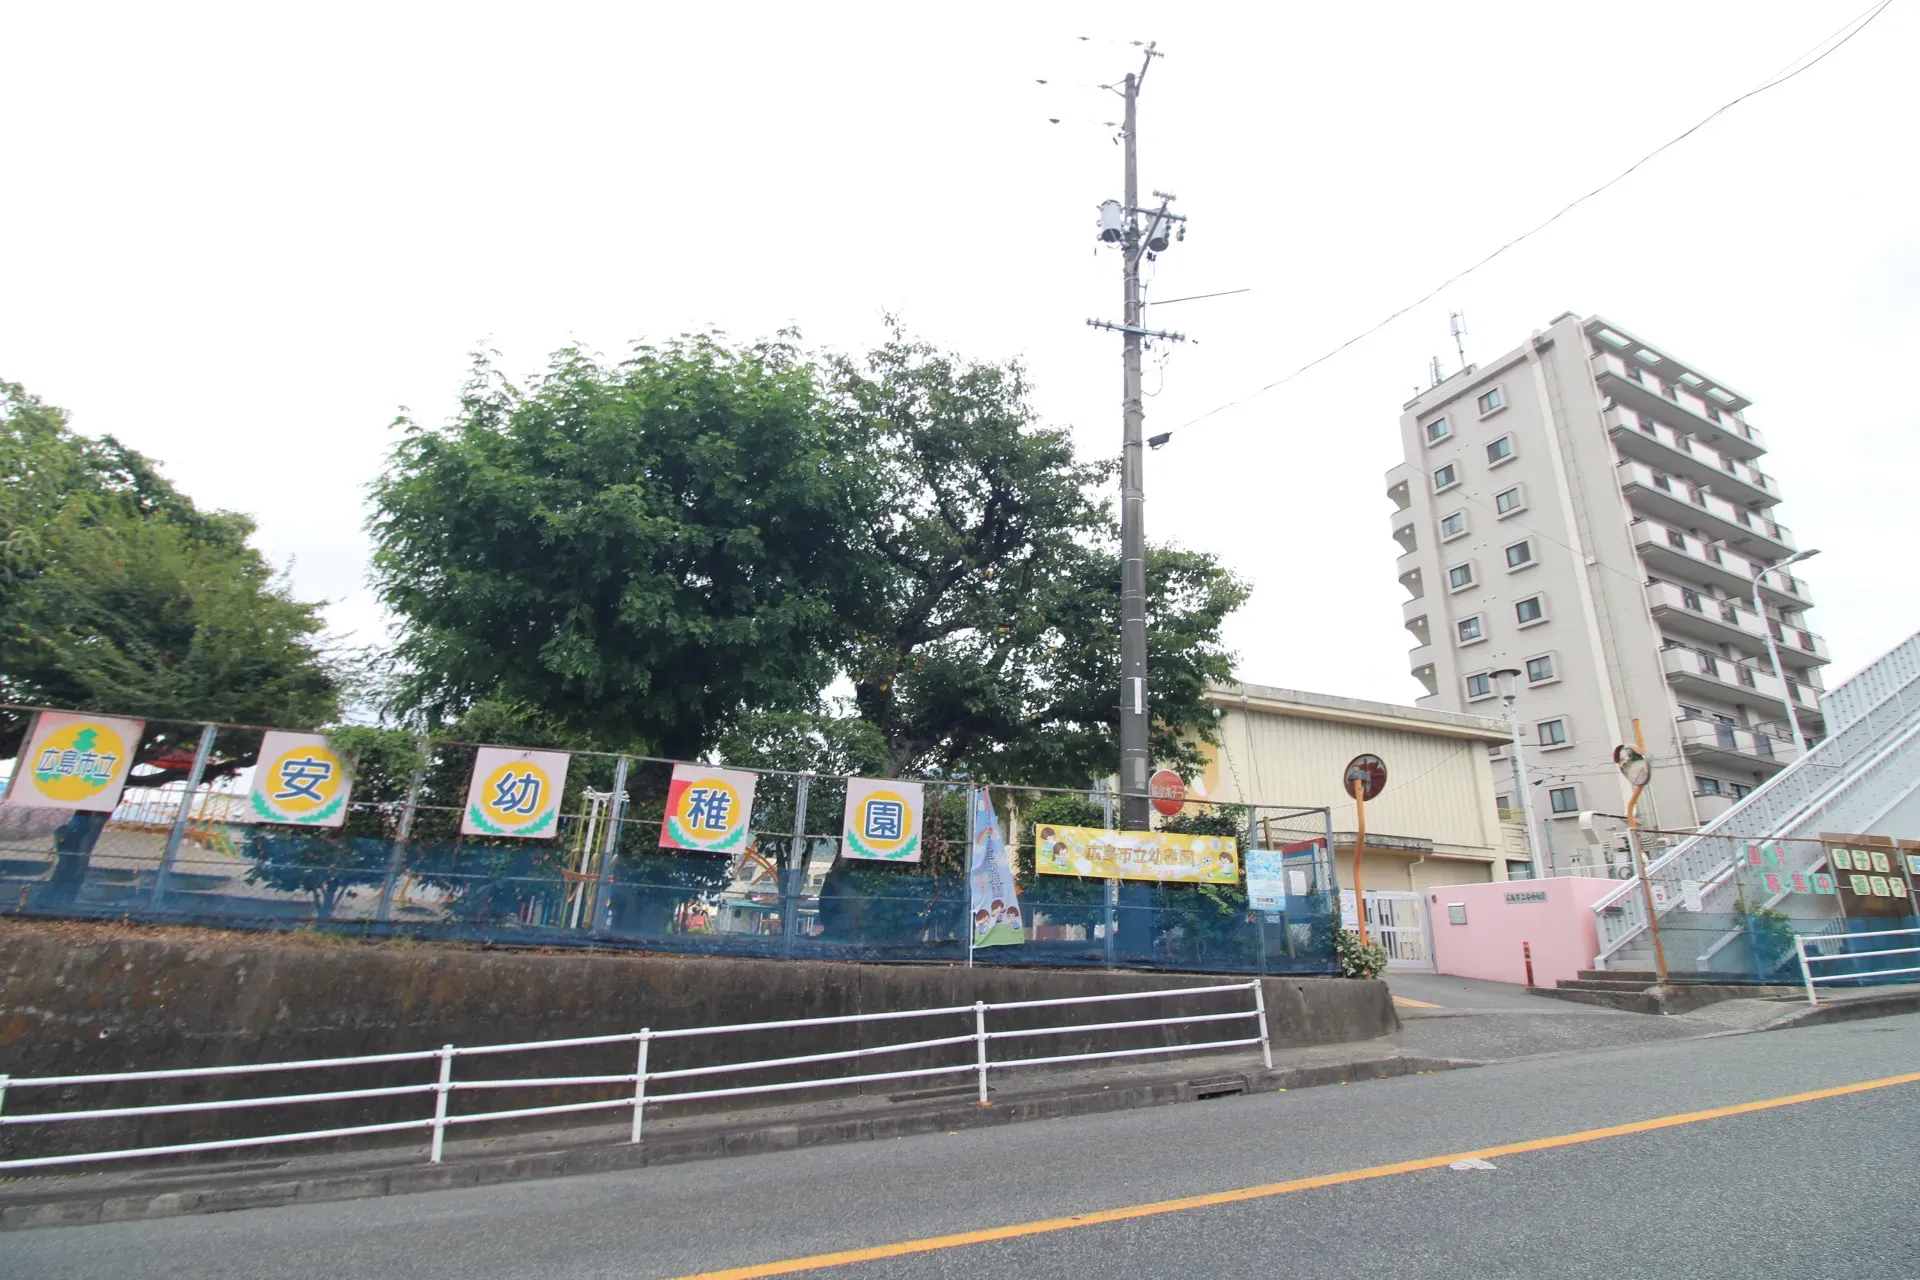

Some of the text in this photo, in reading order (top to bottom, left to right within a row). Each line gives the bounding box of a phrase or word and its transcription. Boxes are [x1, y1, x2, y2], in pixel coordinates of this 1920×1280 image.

[36, 747, 117, 779] 広島市立
[273, 756, 332, 802] 安
[492, 770, 542, 815] 幼
[687, 787, 732, 832] 稚
[864, 799, 903, 841] 園
[1084, 843, 1195, 867] 広島市立幼稚園
[1765, 873, 1830, 894] 募集中
